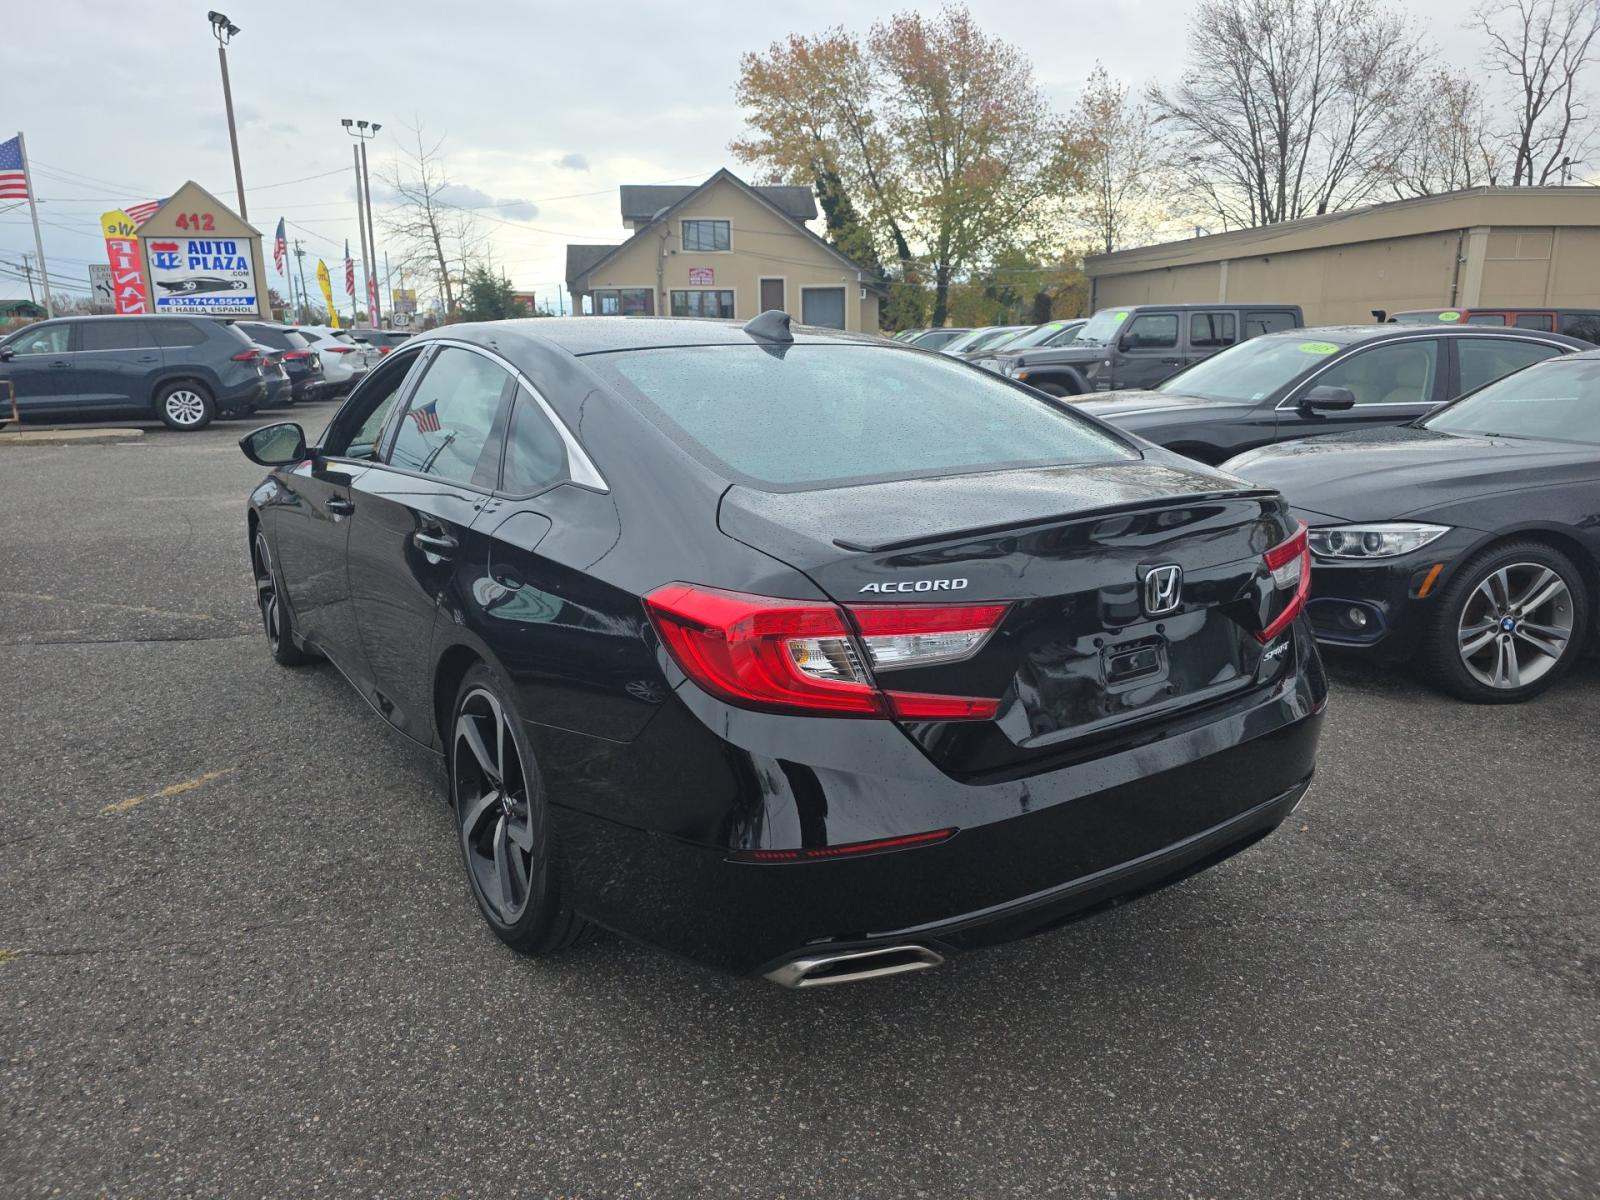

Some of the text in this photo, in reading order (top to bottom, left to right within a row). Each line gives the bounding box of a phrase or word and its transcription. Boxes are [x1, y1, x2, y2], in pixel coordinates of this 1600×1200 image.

[176, 212, 216, 231] 412
[187, 240, 237, 255] AUTO
[151, 253, 182, 267] 112
[188, 256, 249, 271] PLAZA
[168, 298, 248, 306] 631.714.5544
[858, 577, 969, 594] ACCORD
